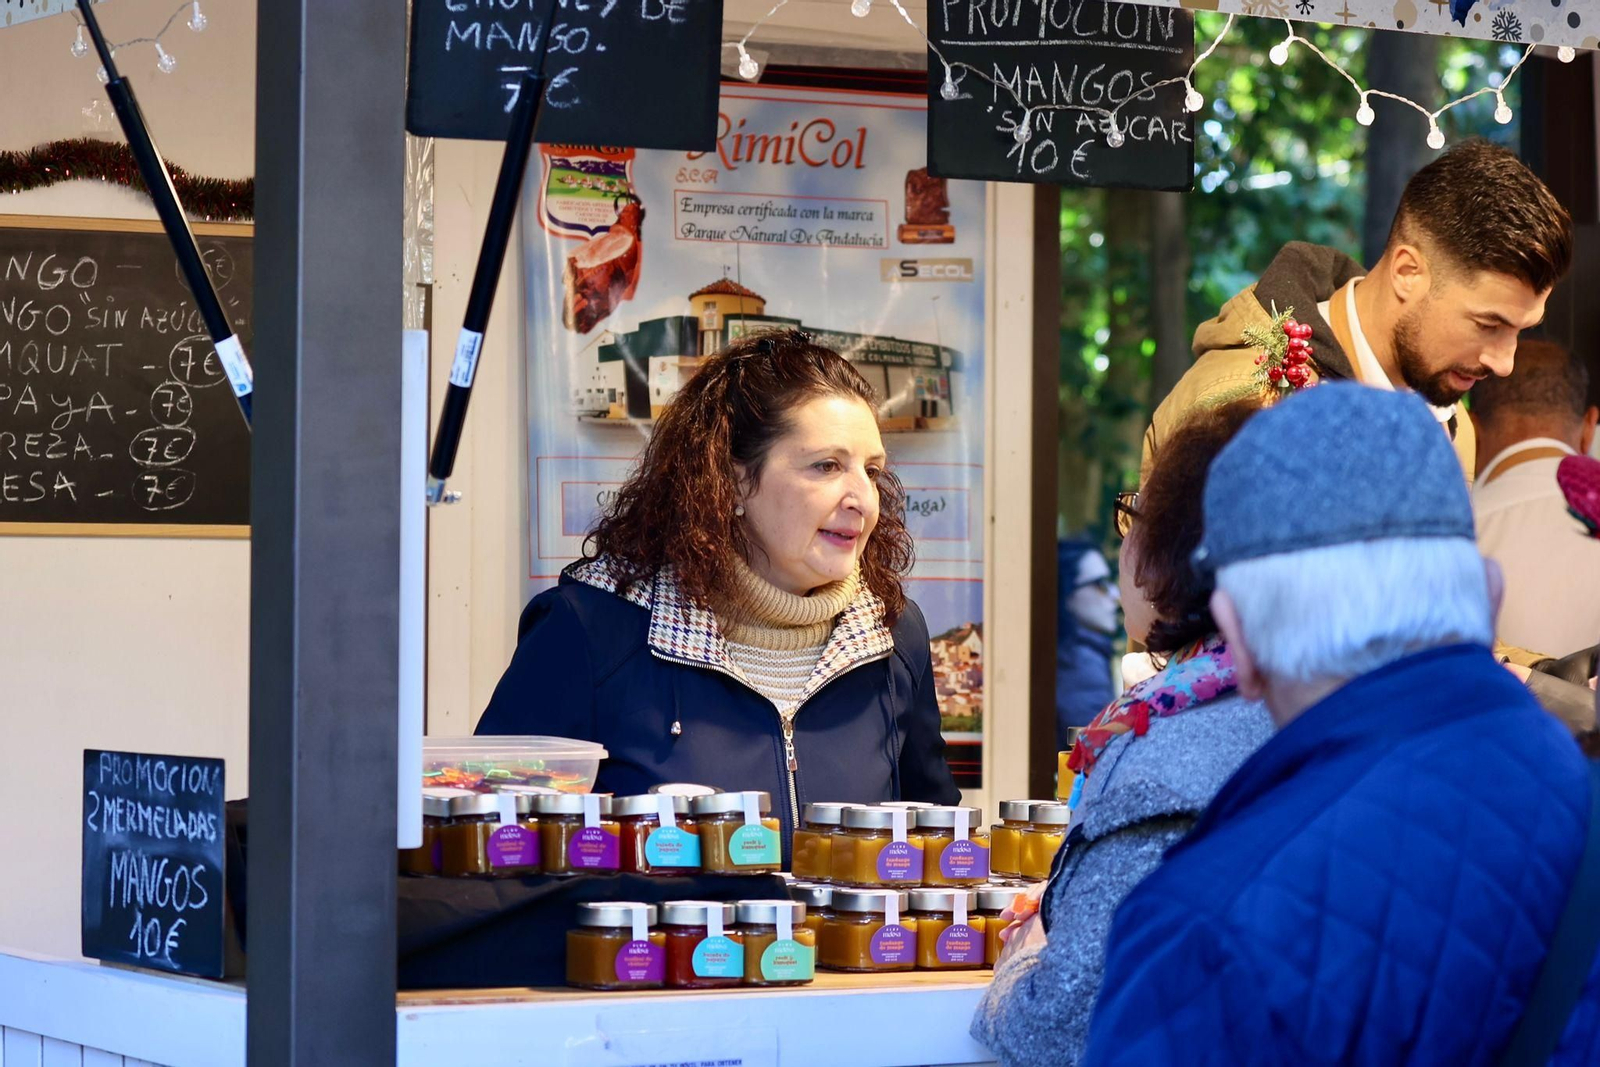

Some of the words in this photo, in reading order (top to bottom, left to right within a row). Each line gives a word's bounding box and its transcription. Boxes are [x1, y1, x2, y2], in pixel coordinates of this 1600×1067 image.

[993, 60, 1156, 107] MANGOS
[686, 112, 867, 170] RimiCol
[680, 197, 735, 217] Empresa
[737, 201, 797, 222] certificada
[800, 207, 820, 219] con
[823, 206, 834, 220] la
[837, 211, 874, 221] marca
[681, 222, 727, 241] Parque
[729, 226, 787, 243] Natural
[790, 228, 813, 244] De
[100, 753, 220, 796] PROMOCION
[103, 796, 217, 844] MERMELADAS
[110, 851, 208, 913] MANGOS
